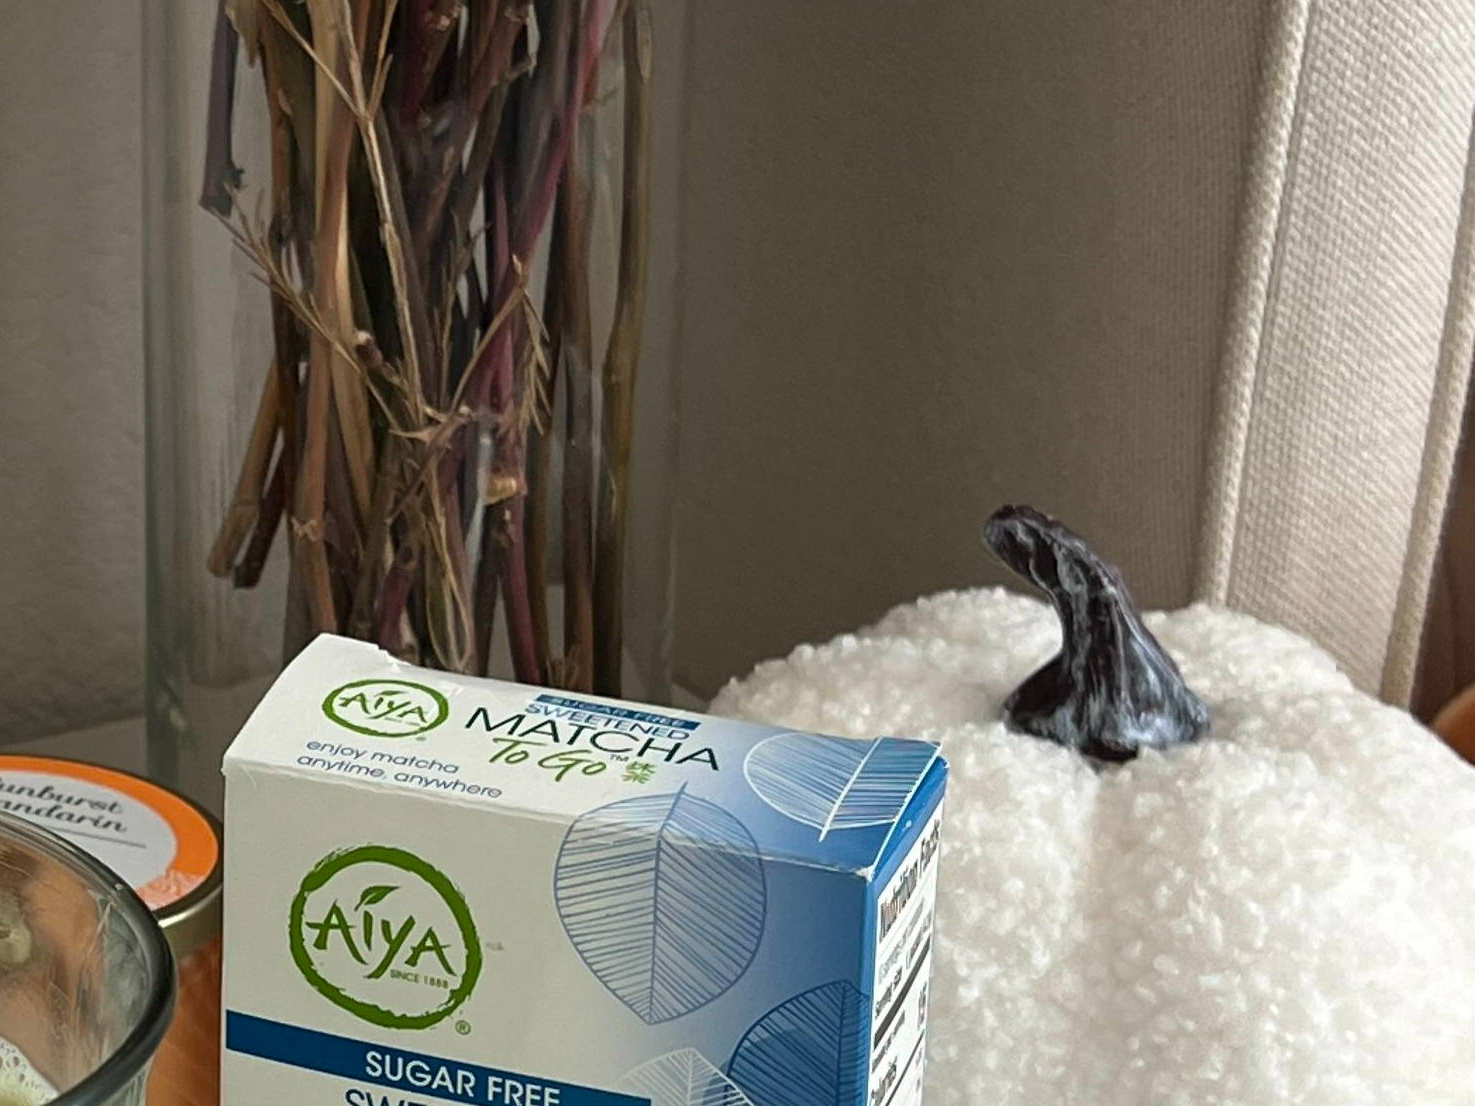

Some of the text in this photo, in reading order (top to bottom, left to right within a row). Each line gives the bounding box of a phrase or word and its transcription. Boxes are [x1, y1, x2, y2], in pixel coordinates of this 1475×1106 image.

[465, 707, 720, 771] MATCHA
[525, 703, 690, 741] SWEETENED
[306, 740, 460, 774] enjoy matcha
[489, 737, 549, 764] To
[537, 749, 607, 782] Go
[394, 771, 503, 798] anywhere
[390, 968, 450, 990] SINCE 1888
[365, 1050, 476, 1098] SUGAR
